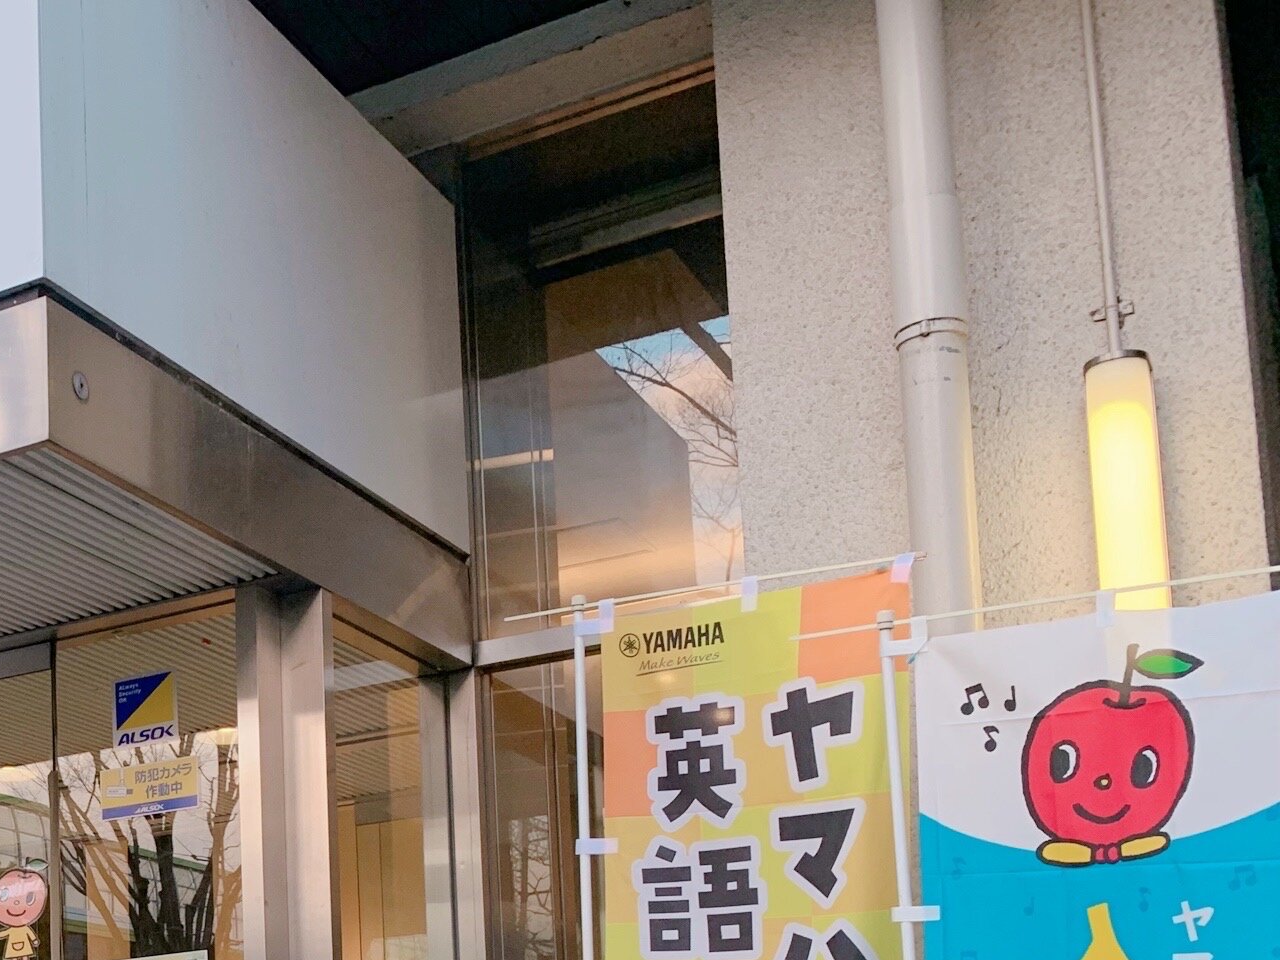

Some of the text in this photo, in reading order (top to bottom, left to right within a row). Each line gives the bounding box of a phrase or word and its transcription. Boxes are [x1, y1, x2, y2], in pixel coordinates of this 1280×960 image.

[642, 621, 725, 654] YAMAHA
[640, 651, 721, 671] Make Waves
[118, 724, 174, 746] ALSOK
[135, 763, 192, 784] 防犯カメラ
[145, 781, 182, 799] 作動中
